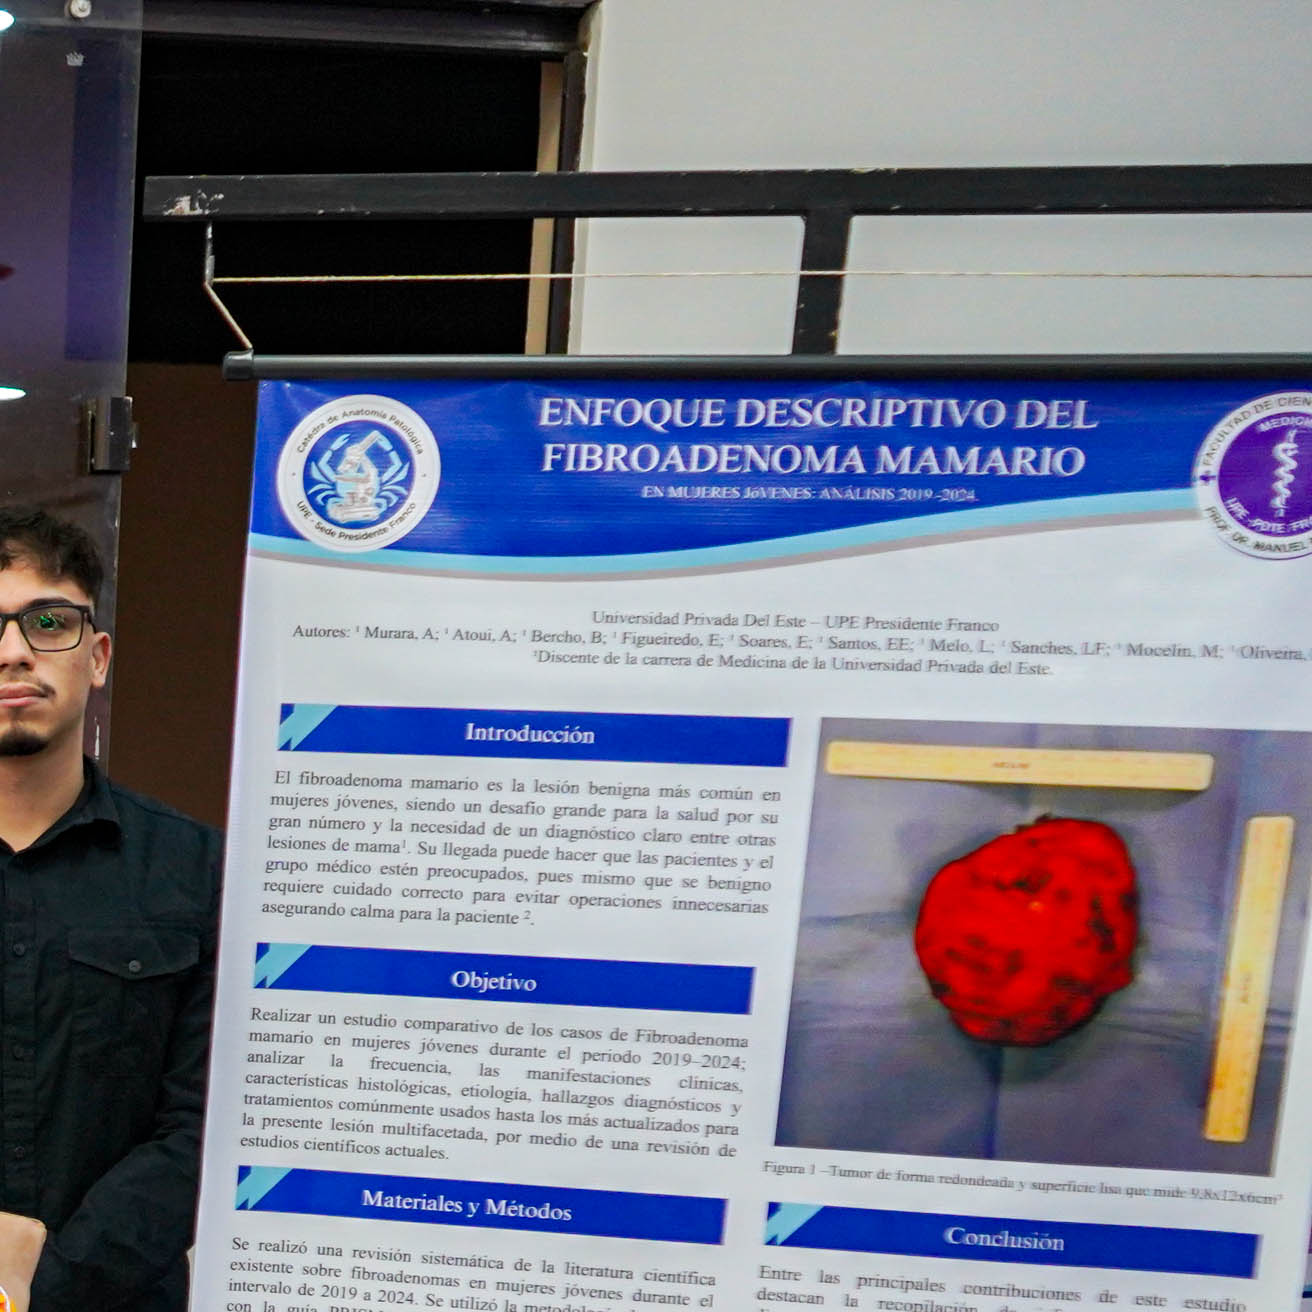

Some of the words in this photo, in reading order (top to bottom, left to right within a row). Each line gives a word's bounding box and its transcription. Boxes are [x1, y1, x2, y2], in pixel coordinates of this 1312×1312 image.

[539, 398, 725, 432] ENFOQUE
[736, 398, 1006, 428] DESCRIPTIVO
[1015, 400, 1098, 429] DEL
[542, 443, 866, 474] FIBROADENOMA
[875, 446, 1085, 476] MAMARIO
[593, 610, 679, 626] Universidad
[684, 612, 738, 627] Privada
[744, 614, 770, 627] Del
[774, 614, 806, 628] Este
[826, 615, 858, 629] UPE
[864, 616, 942, 631] Presidente
[946, 618, 999, 632] Franco
[466, 723, 594, 744] Introducción
[275, 770, 290, 784] El
[300, 771, 402, 788] fibroadenoma
[411, 777, 479, 791] mamario
[487, 781, 502, 792] es
[512, 778, 524, 793] la
[534, 779, 579, 794] lesión
[589, 781, 650, 800] benigna
[659, 784, 690, 798] más
[700, 787, 752, 800] común
[762, 791, 780, 801] en
[452, 970, 536, 993] Objetivo
[363, 1190, 462, 1213] Materiales
[467, 1201, 479, 1217] y
[486, 1199, 571, 1221] Métodos
[945, 1227, 1064, 1251] Conclusión
[232, 1237, 249, 1251] Se
[259, 1239, 307, 1254] realizó
[317, 1246, 342, 1257] una
[352, 1247, 411, 1263] revisión
[421, 1252, 503, 1270] sistemática
[514, 1258, 531, 1272] de
[542, 1260, 554, 1274] la
[565, 1262, 633, 1280] literatura
[644, 1269, 715, 1286] científica
[759, 1265, 802, 1281] Entre
[818, 1270, 840, 1285] las
[856, 1274, 945, 1293] principales
[963, 1284, 1081, 1302] contribuciones
[1098, 1289, 1117, 1304] de
[1136, 1295, 1167, 1307] este
[1184, 1298, 1246, 1312] estudio
